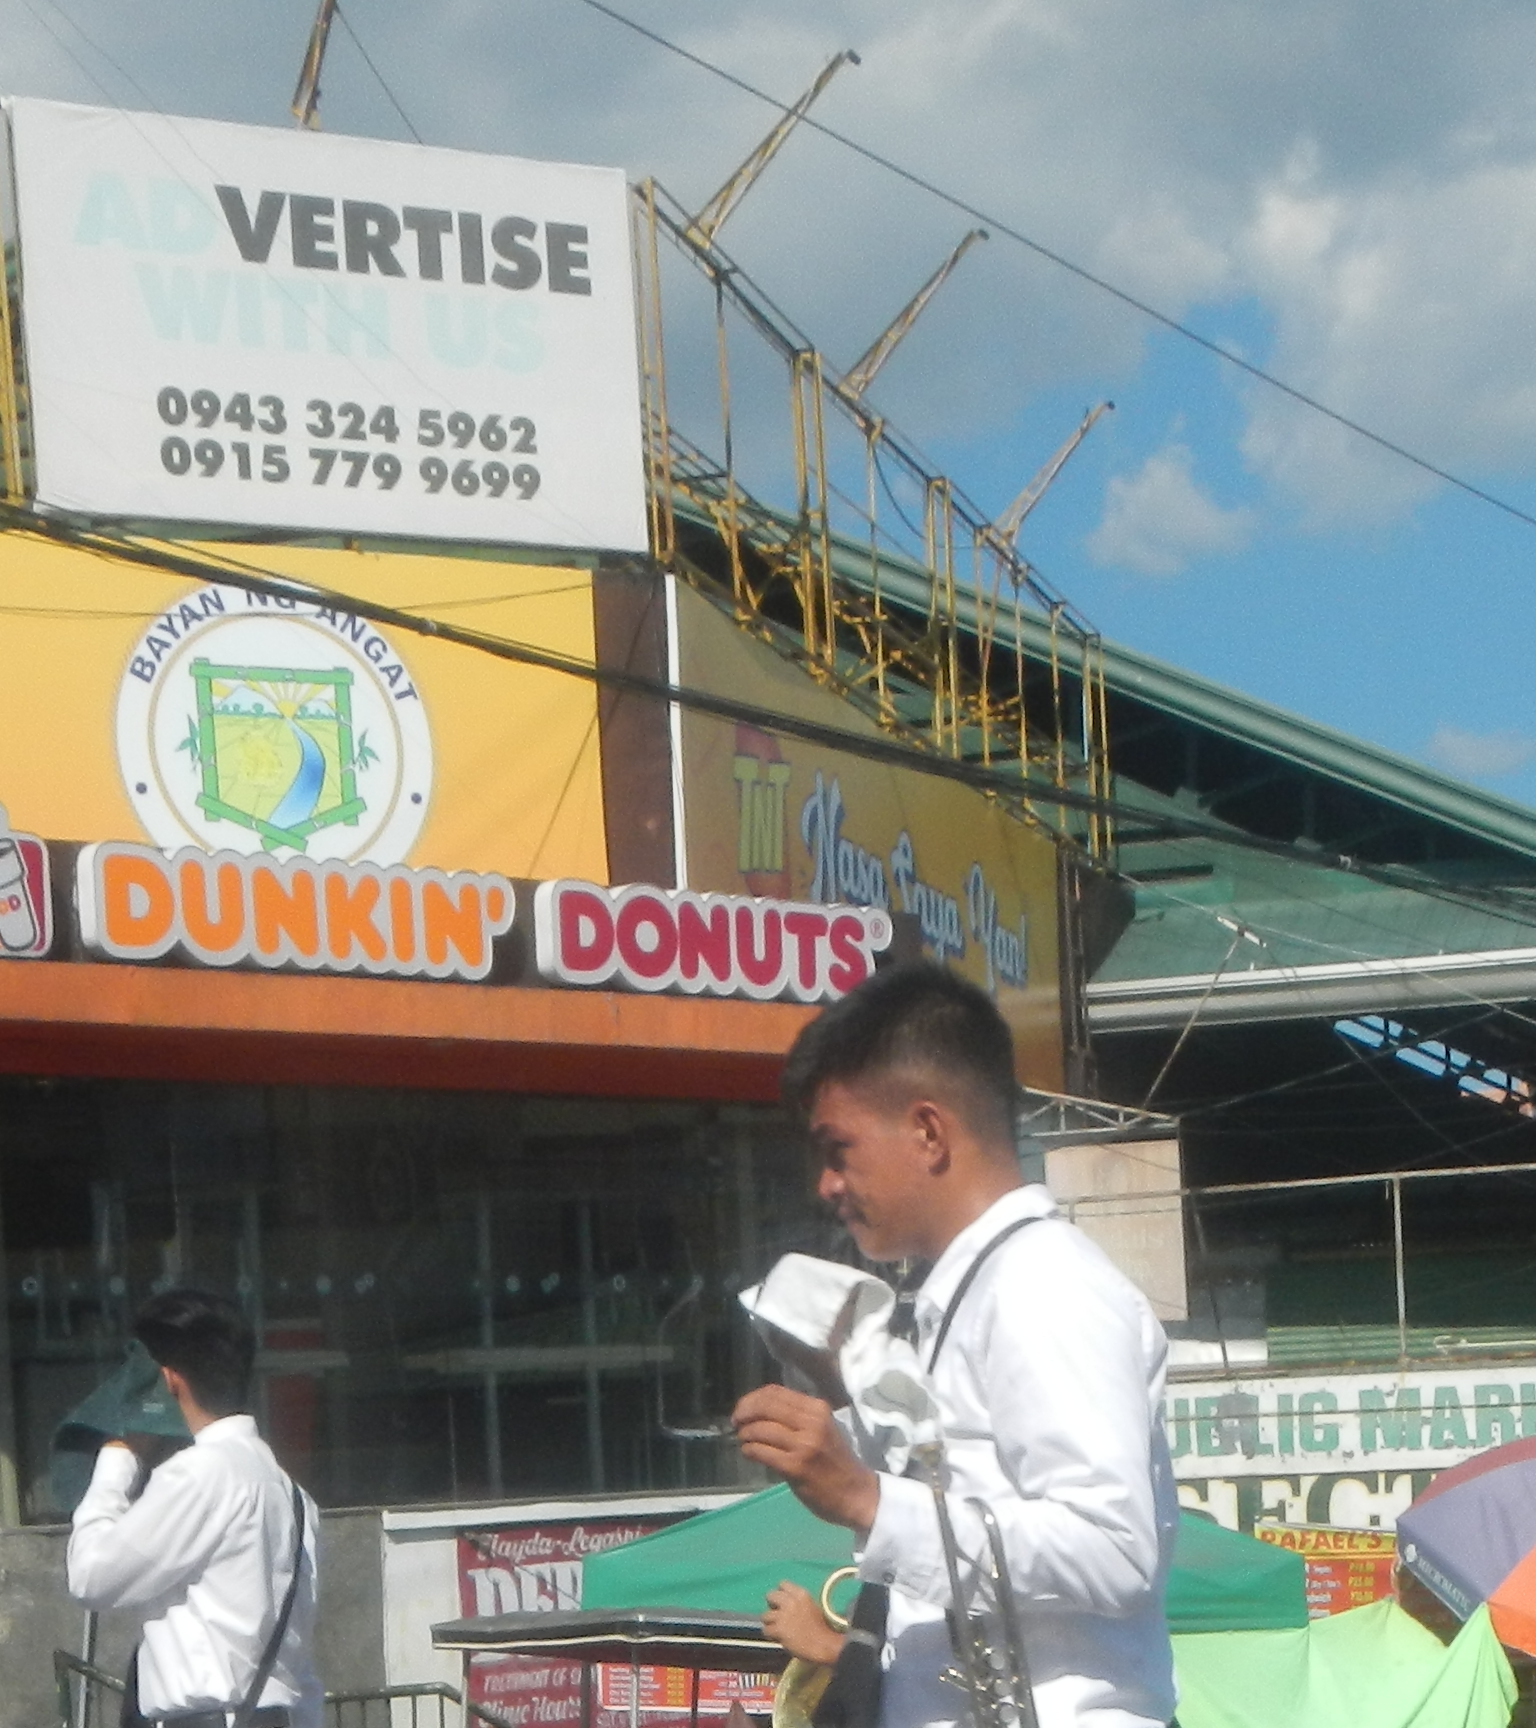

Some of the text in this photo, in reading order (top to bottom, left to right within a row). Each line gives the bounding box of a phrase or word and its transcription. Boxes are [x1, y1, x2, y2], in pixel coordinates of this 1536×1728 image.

[73, 172, 592, 296] ADVERTISE
[134, 262, 547, 375] WITH US
[157, 386, 539, 455] 0943 324 5962
[160, 435, 542, 501] 0915 779 9699
[128, 588, 420, 702] BAYAN NG ANGAT
[102, 853, 867, 997] DUNKIN' DONUTS
[1168, 1390, 1341, 1460] UBLIC
